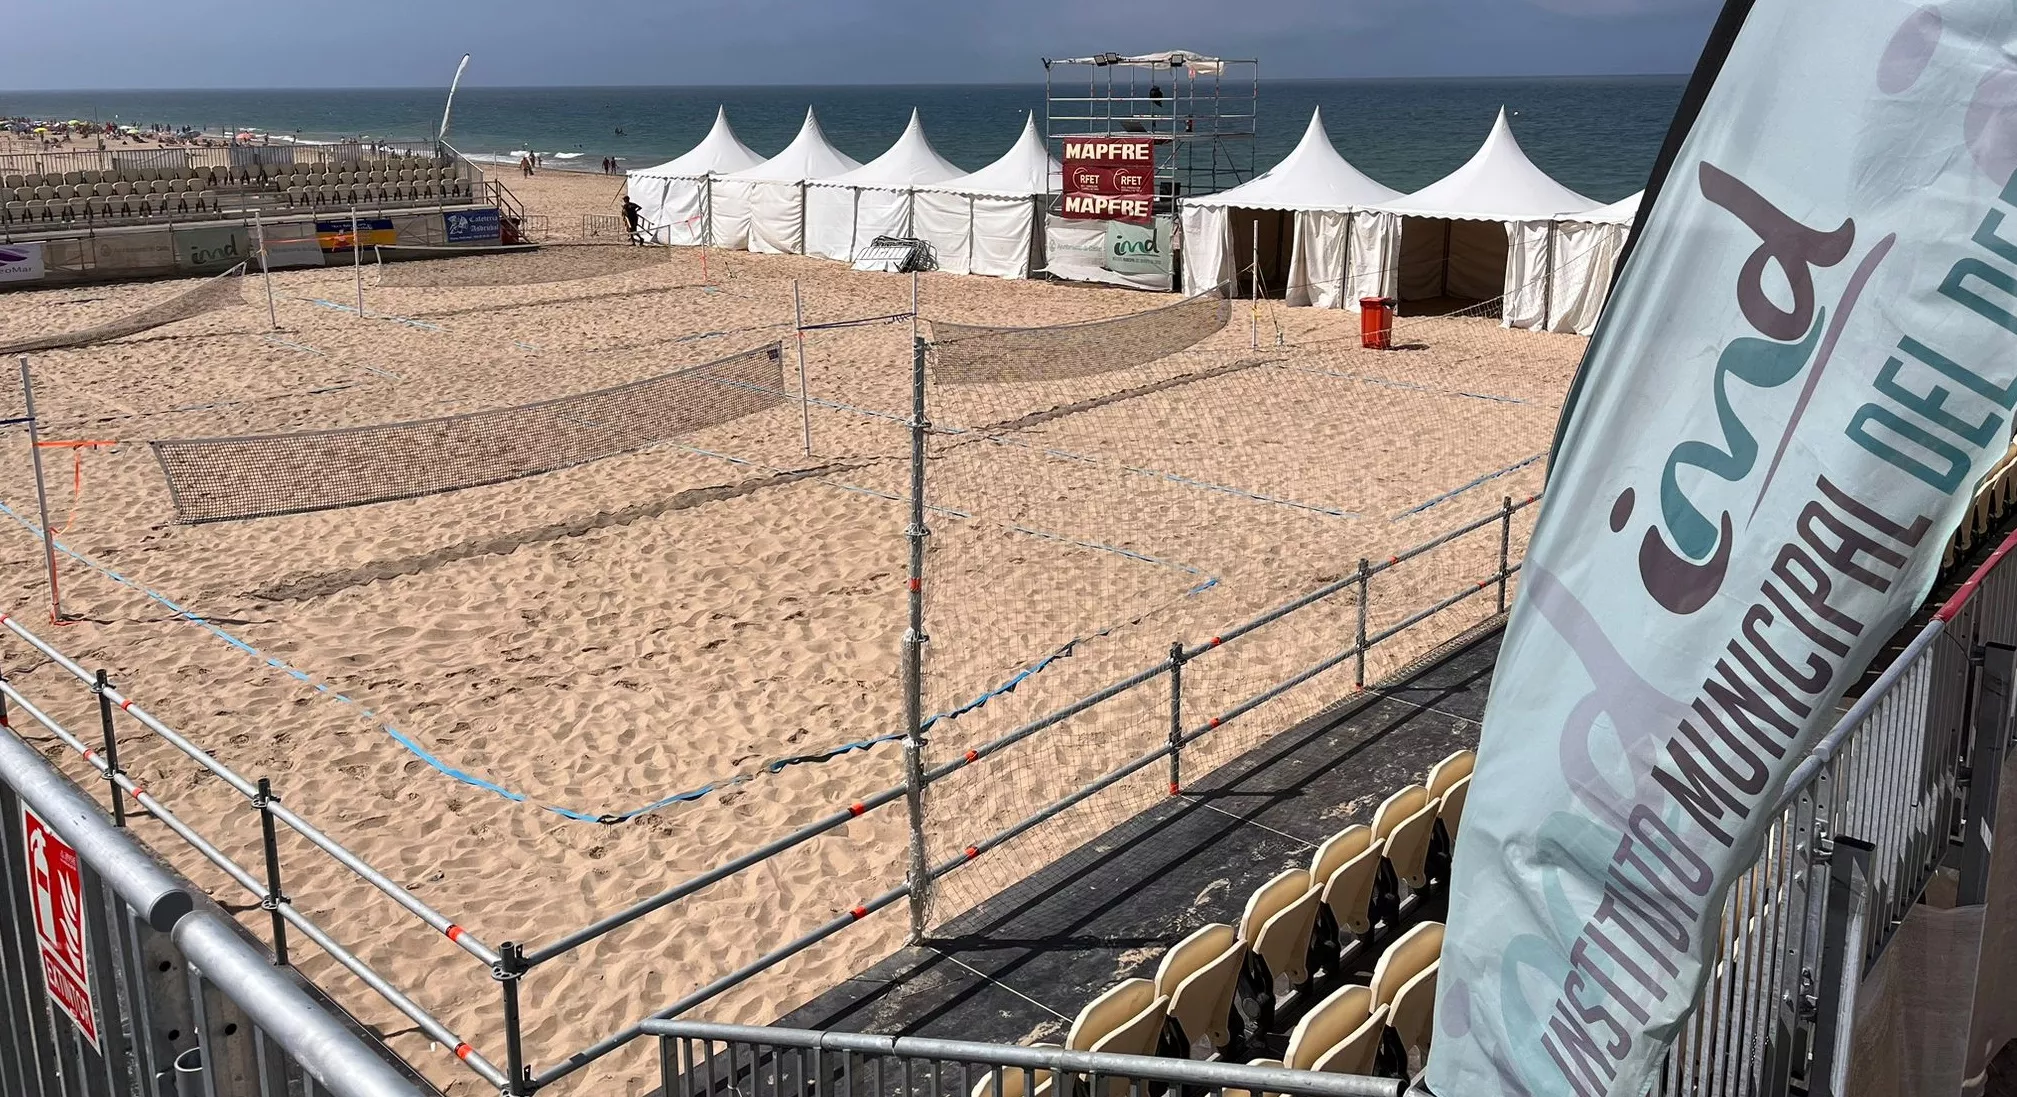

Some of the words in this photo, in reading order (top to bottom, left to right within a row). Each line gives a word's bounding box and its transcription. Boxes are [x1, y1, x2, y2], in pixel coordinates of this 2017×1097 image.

[1065, 143, 1149, 160] MAPFRE
[1080, 174, 1100, 184] RFET
[1120, 175, 1142, 186] RFET
[1065, 196, 1149, 217] MAPFRE
[1540, 803, 1714, 1097] INSTITUTO
[1651, 474, 1934, 849] MUNICIPAL
[1844, 334, 2017, 496] DEL
[44, 954, 93, 1030] EXTINTOR
